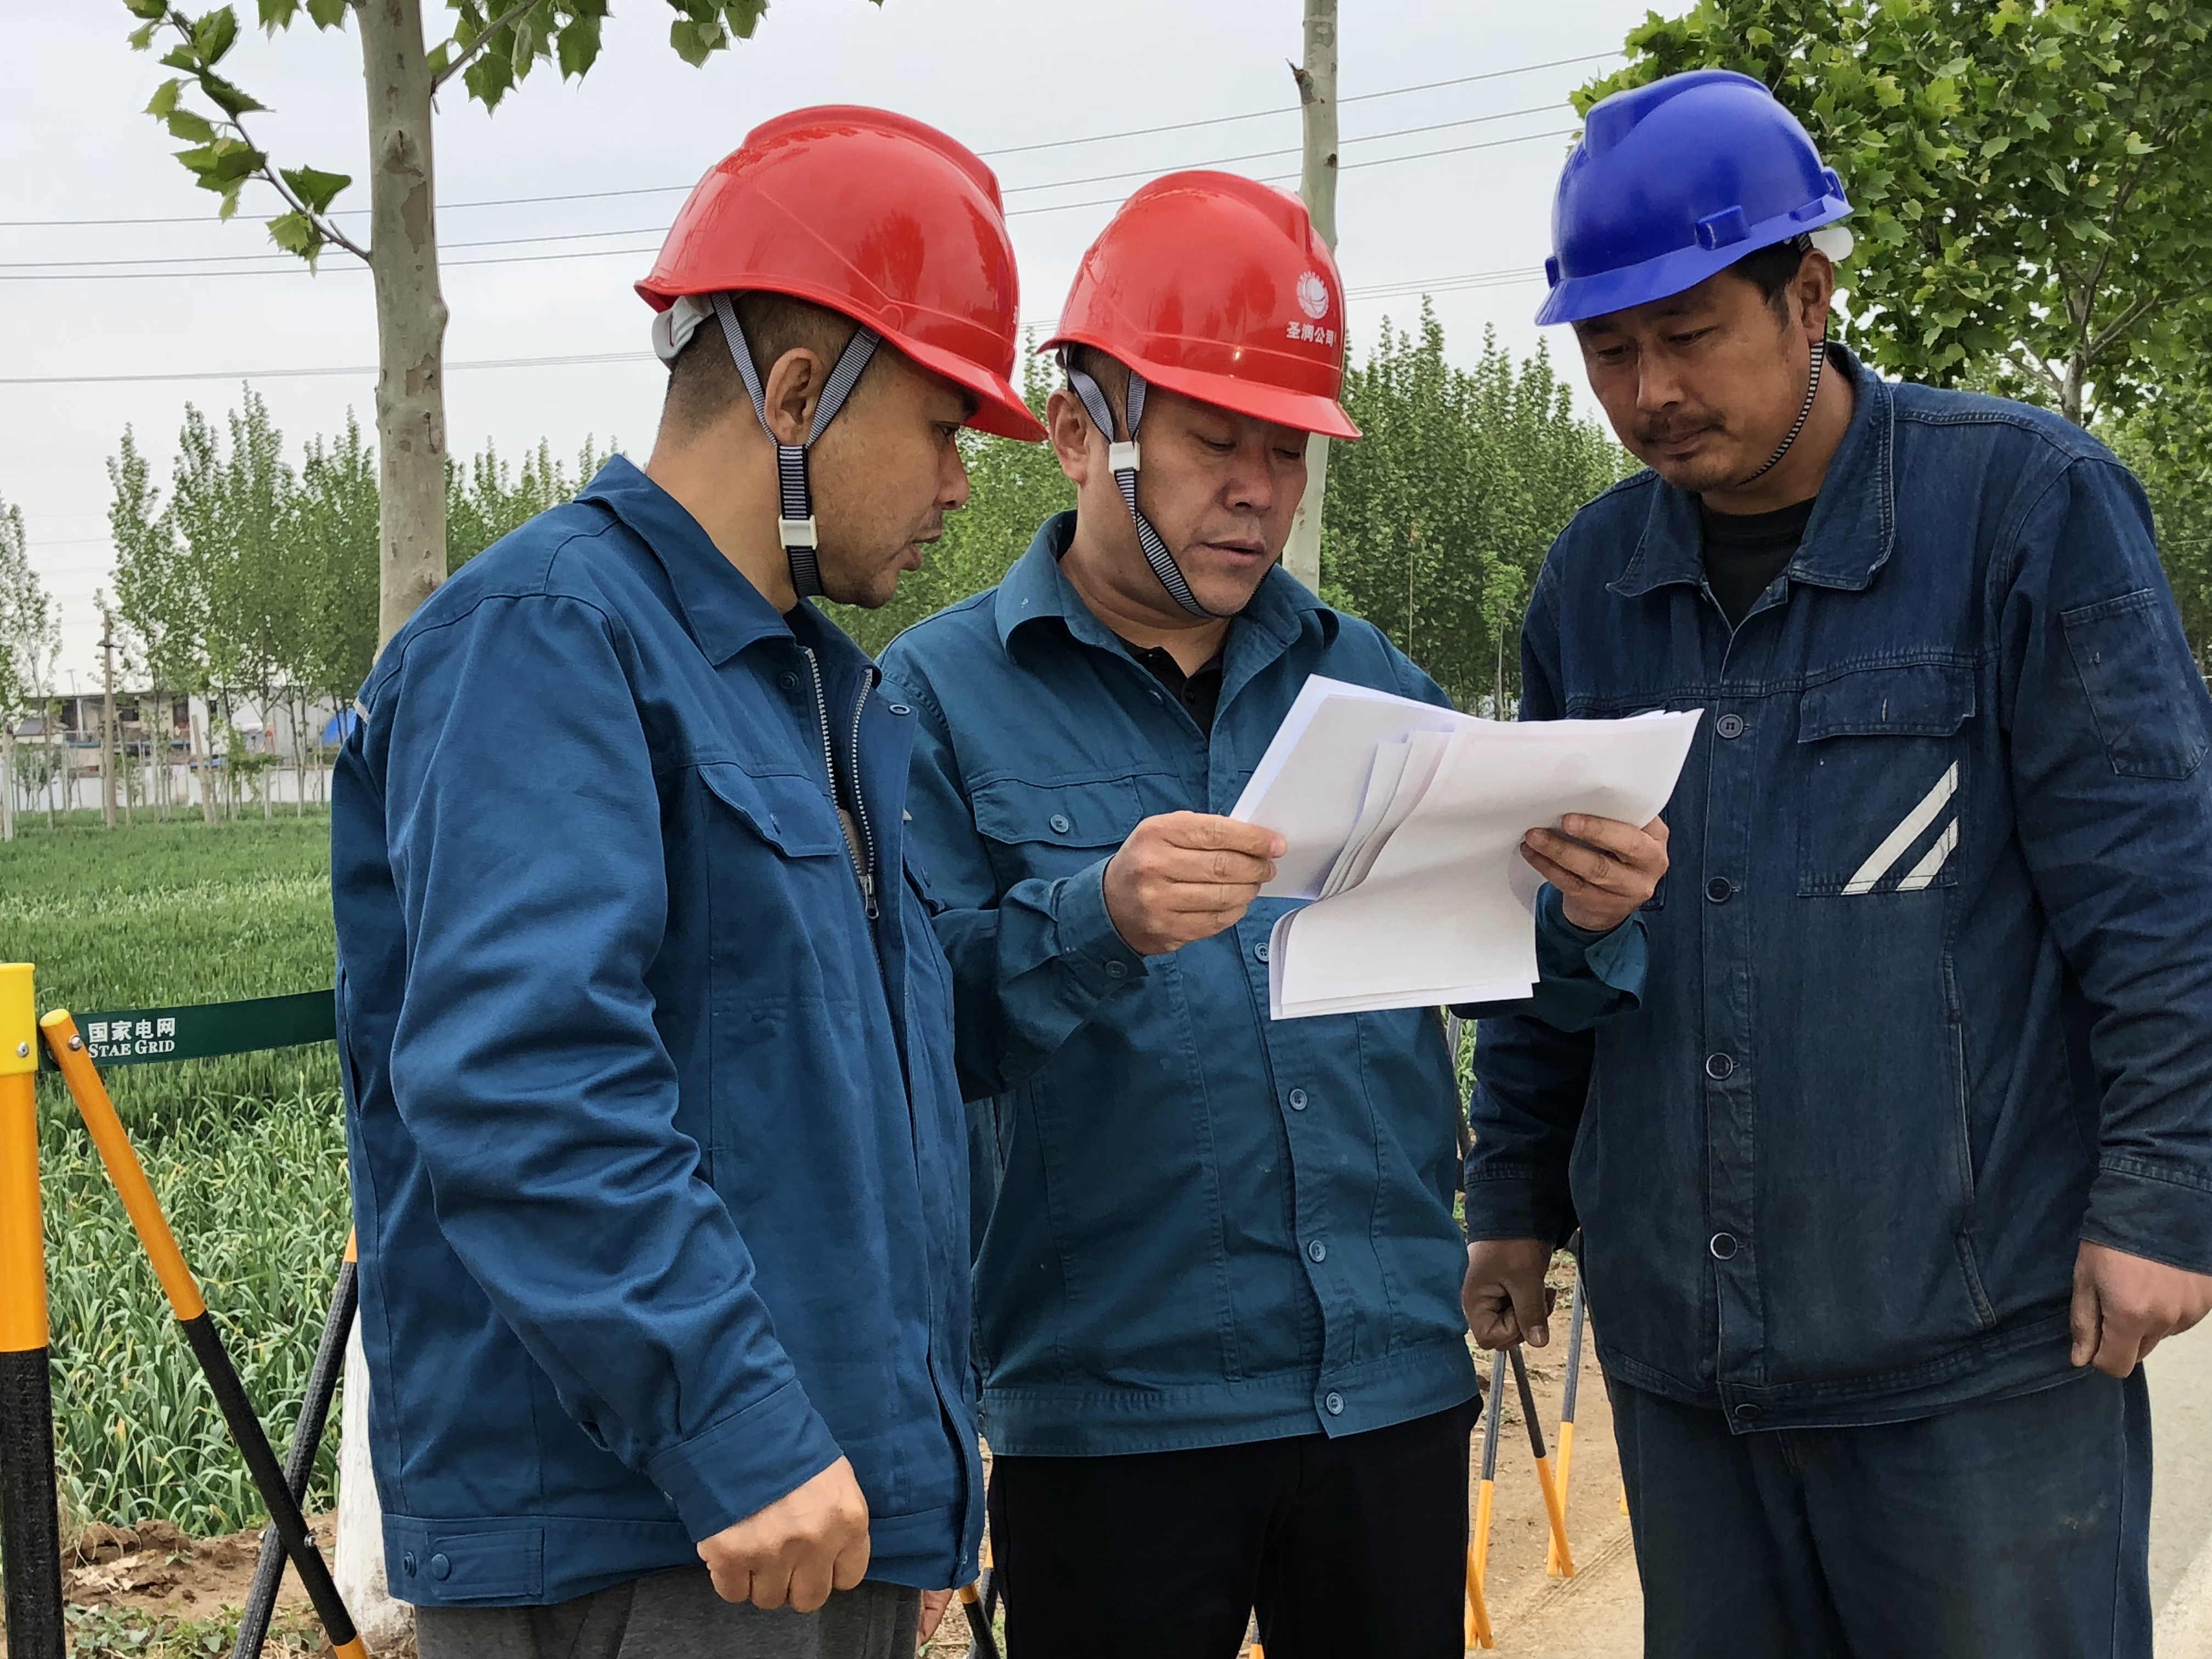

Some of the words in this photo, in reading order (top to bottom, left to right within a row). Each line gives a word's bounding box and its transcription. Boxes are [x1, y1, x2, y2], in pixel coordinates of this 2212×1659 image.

[1286, 320, 1334, 347] 圣润公司
[88, 1017, 176, 1043] 国家电网
[88, 1043, 132, 1058] STAE
[134, 1040, 176, 1054] GRID
